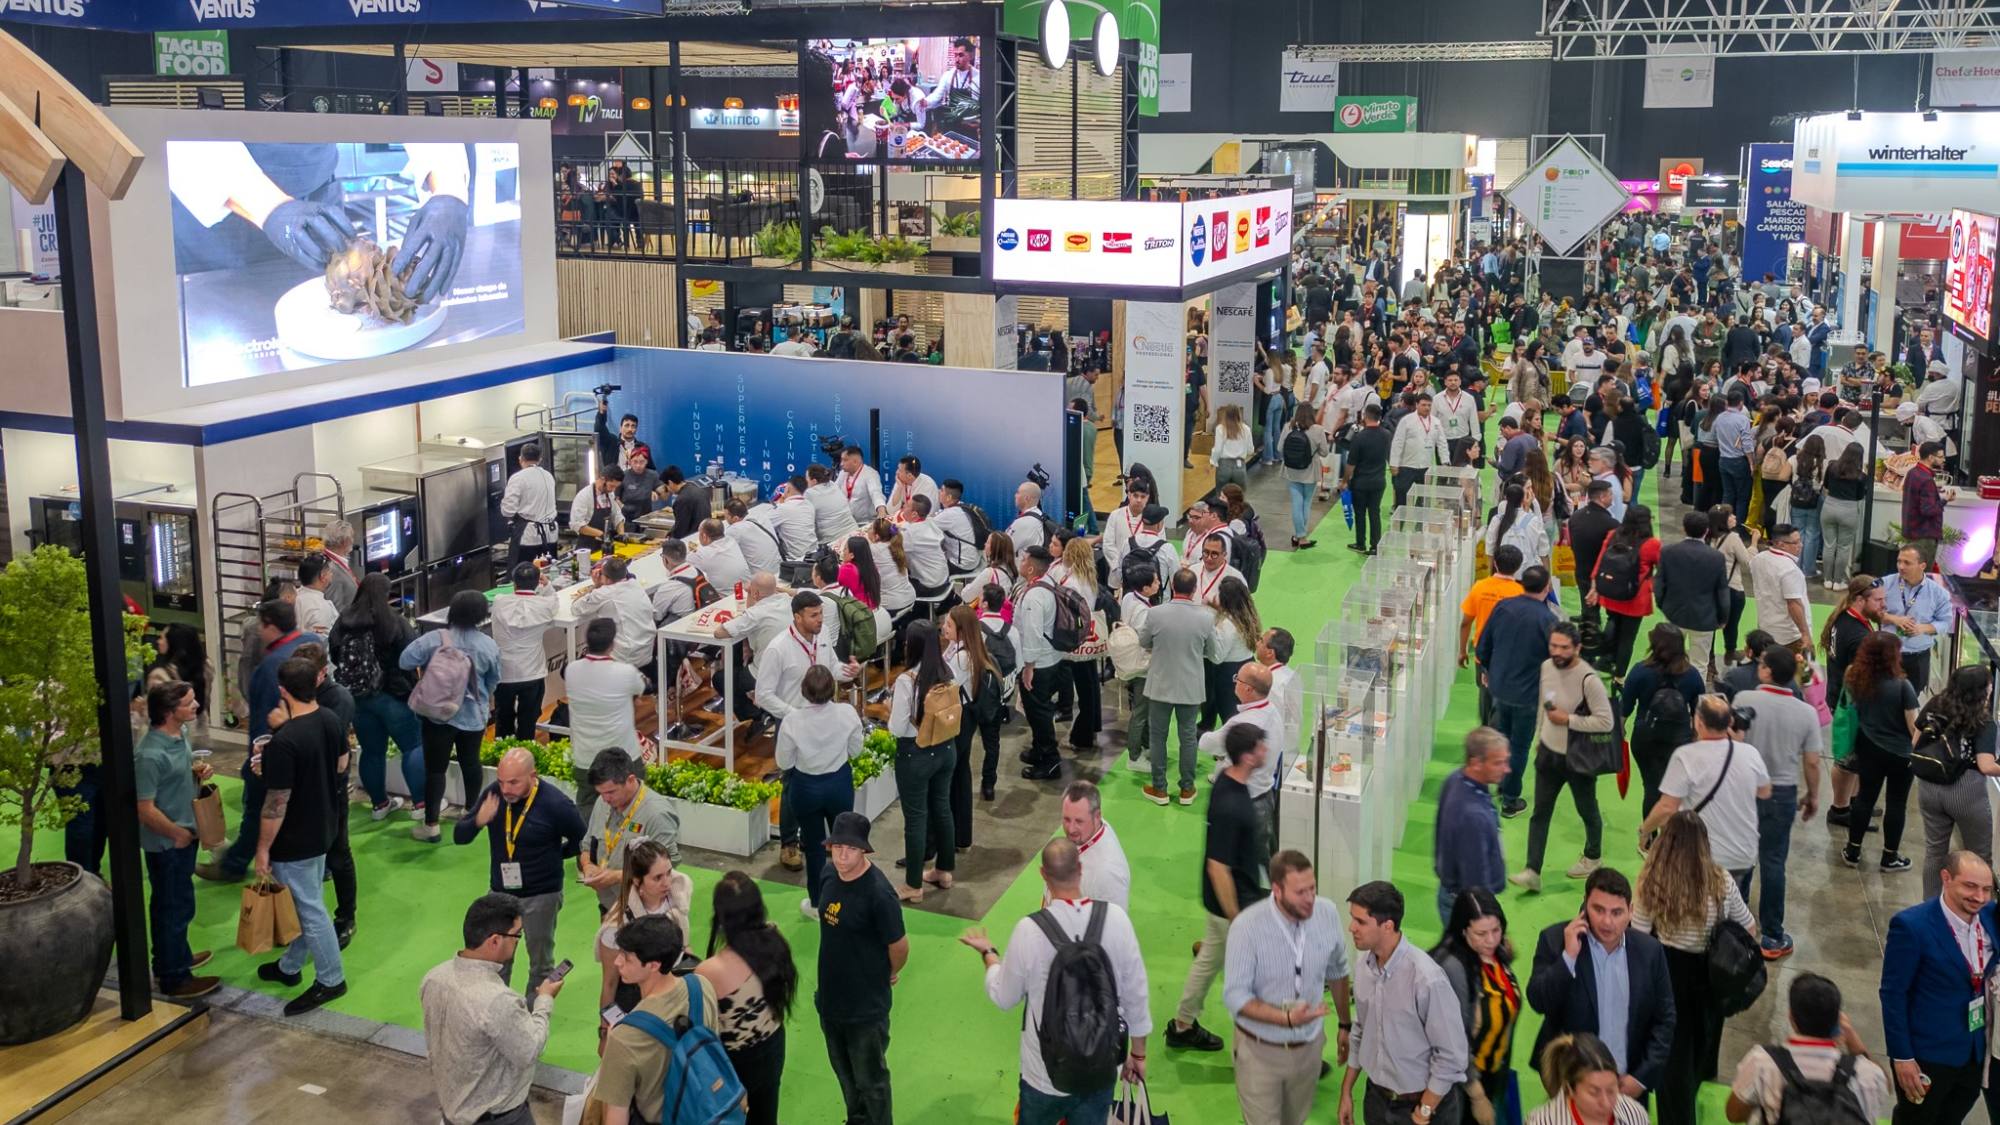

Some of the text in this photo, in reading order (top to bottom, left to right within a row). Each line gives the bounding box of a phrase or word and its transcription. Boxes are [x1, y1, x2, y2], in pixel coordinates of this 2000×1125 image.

[158, 37, 225, 57] TAGLER
[159, 54, 226, 76] FOOD
[1363, 101, 1400, 113] Minuto
[1868, 144, 1967, 161] winterhalter
[1763, 216, 1805, 225] MARISCO
[1769, 208, 1805, 216] PESCAD
[32, 213, 55, 233] #JU
[1756, 224, 1805, 232] CAMARON
[40, 233, 57, 252] CR
[1144, 239, 1174, 250] TRITON
[1780, 231, 1800, 240] MÁS
[1216, 305, 1255, 316] NESCAFÉ
[833, 392, 842, 433] SERV
[737, 373, 747, 479] SUPERMERCA
[692, 401, 702, 475] INDUSTR
[715, 423, 724, 466] MINE
[786, 410, 796, 474] CASINO
[809, 423, 818, 463] HOTE
[762, 439, 773, 495] INNOV
[882, 429, 891, 494] EFICIE
[1072, 640, 1108, 655] arozzi
